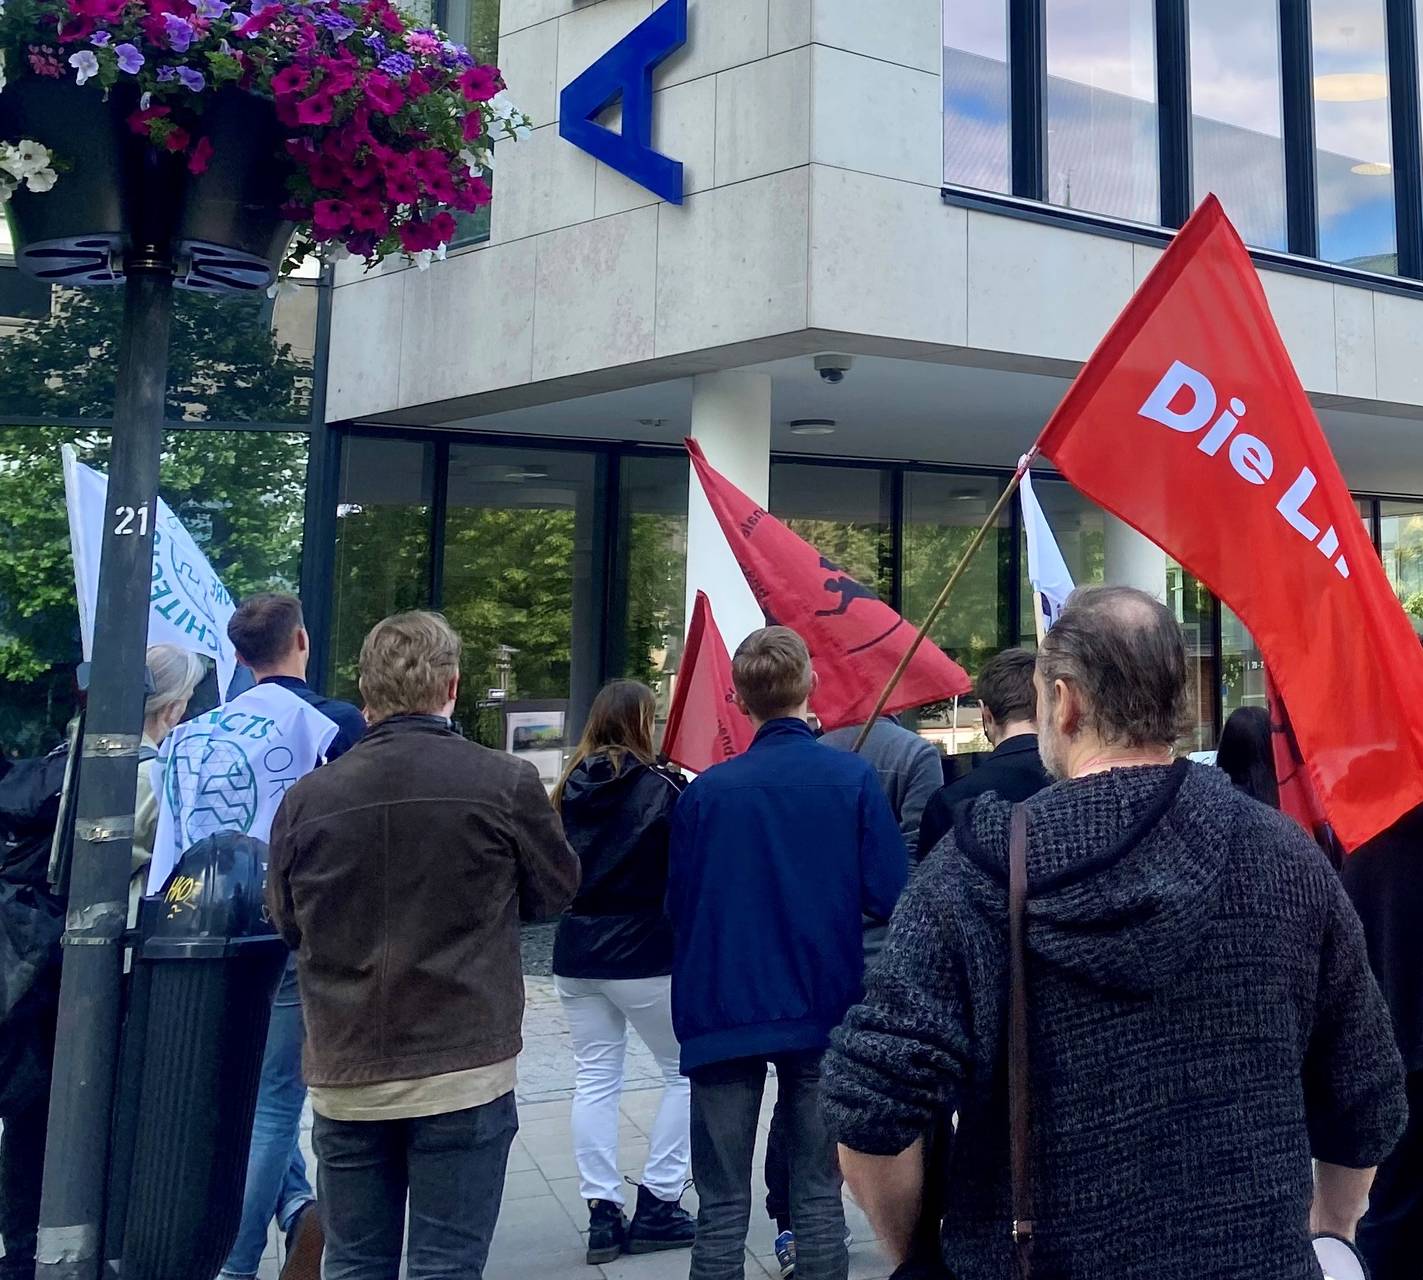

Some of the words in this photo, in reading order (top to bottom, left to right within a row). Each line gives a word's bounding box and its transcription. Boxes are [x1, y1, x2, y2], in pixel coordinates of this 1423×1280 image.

[560, 0, 687, 205] A
[1137, 359, 1274, 487] Die
[114, 506, 147, 536] 21
